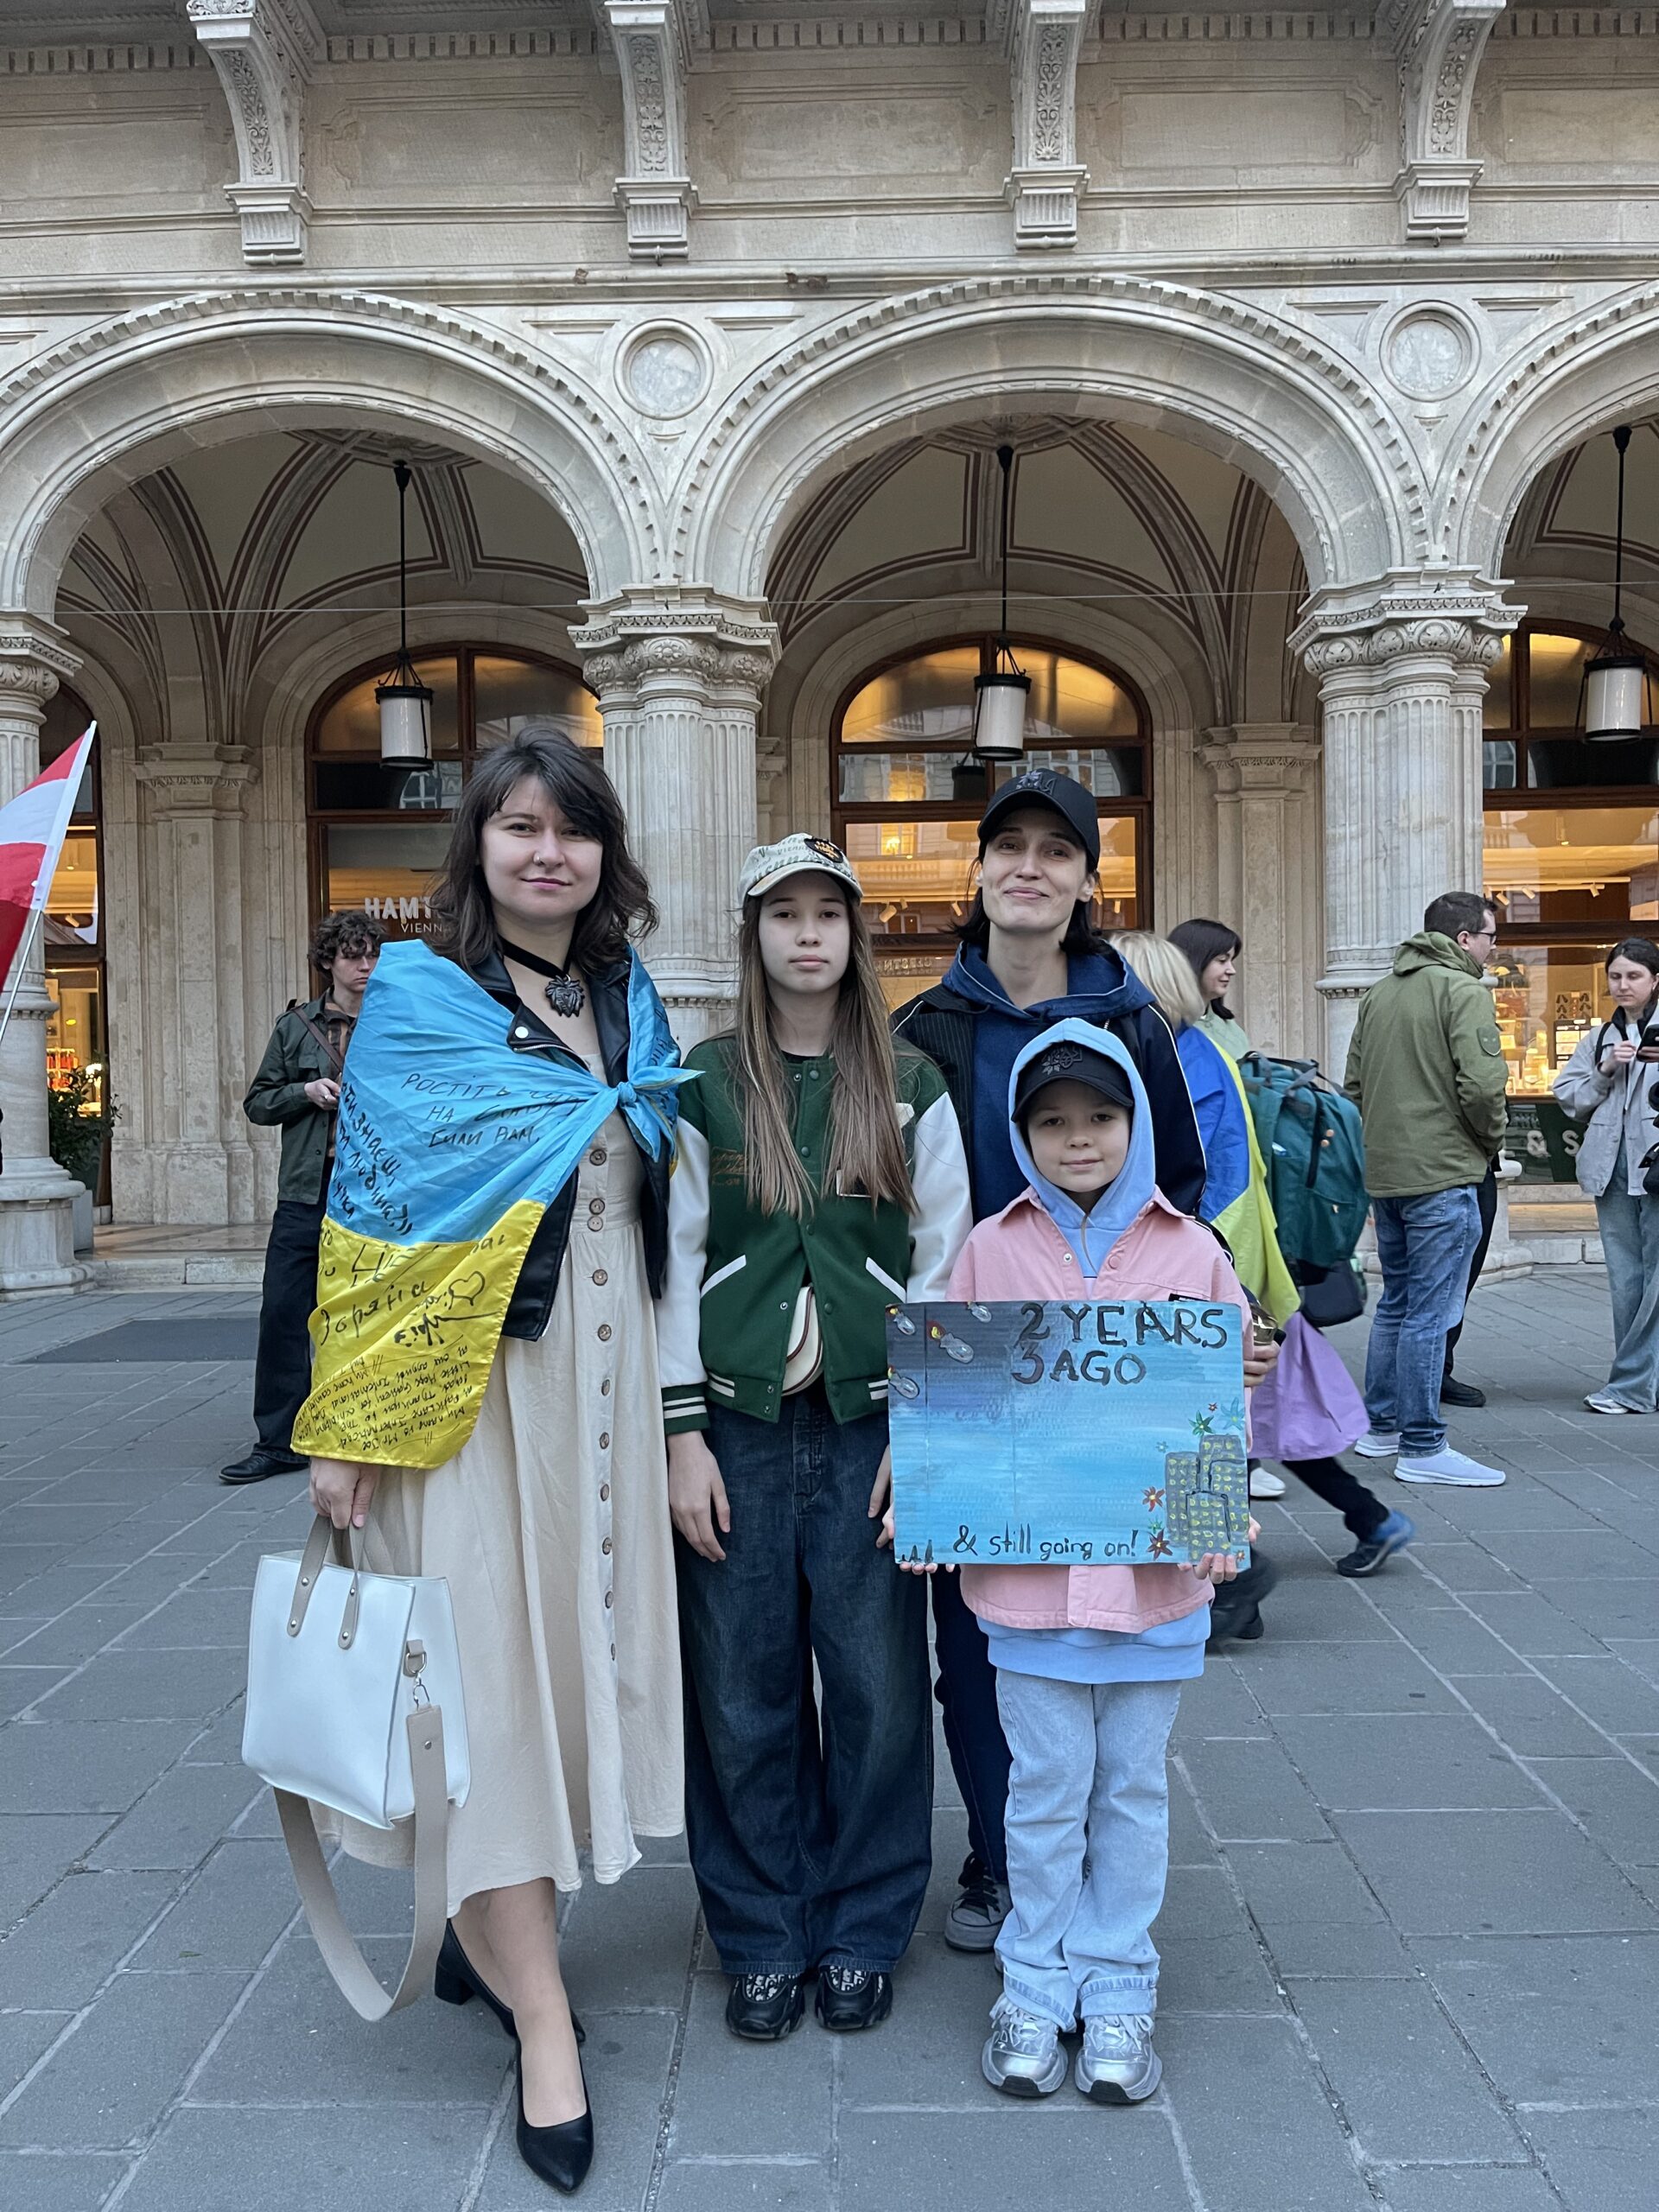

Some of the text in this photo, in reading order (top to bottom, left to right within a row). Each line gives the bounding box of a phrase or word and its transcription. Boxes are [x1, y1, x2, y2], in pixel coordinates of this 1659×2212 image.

[365, 897, 432, 919] HAMT
[400, 923, 443, 933] VIENN
[1526, 1129, 1580, 1158] & S
[1061, 1301, 1228, 1349] YEARS
[1050, 1351, 1147, 1386] AGO
[952, 1522, 1139, 1560] & still going on!
